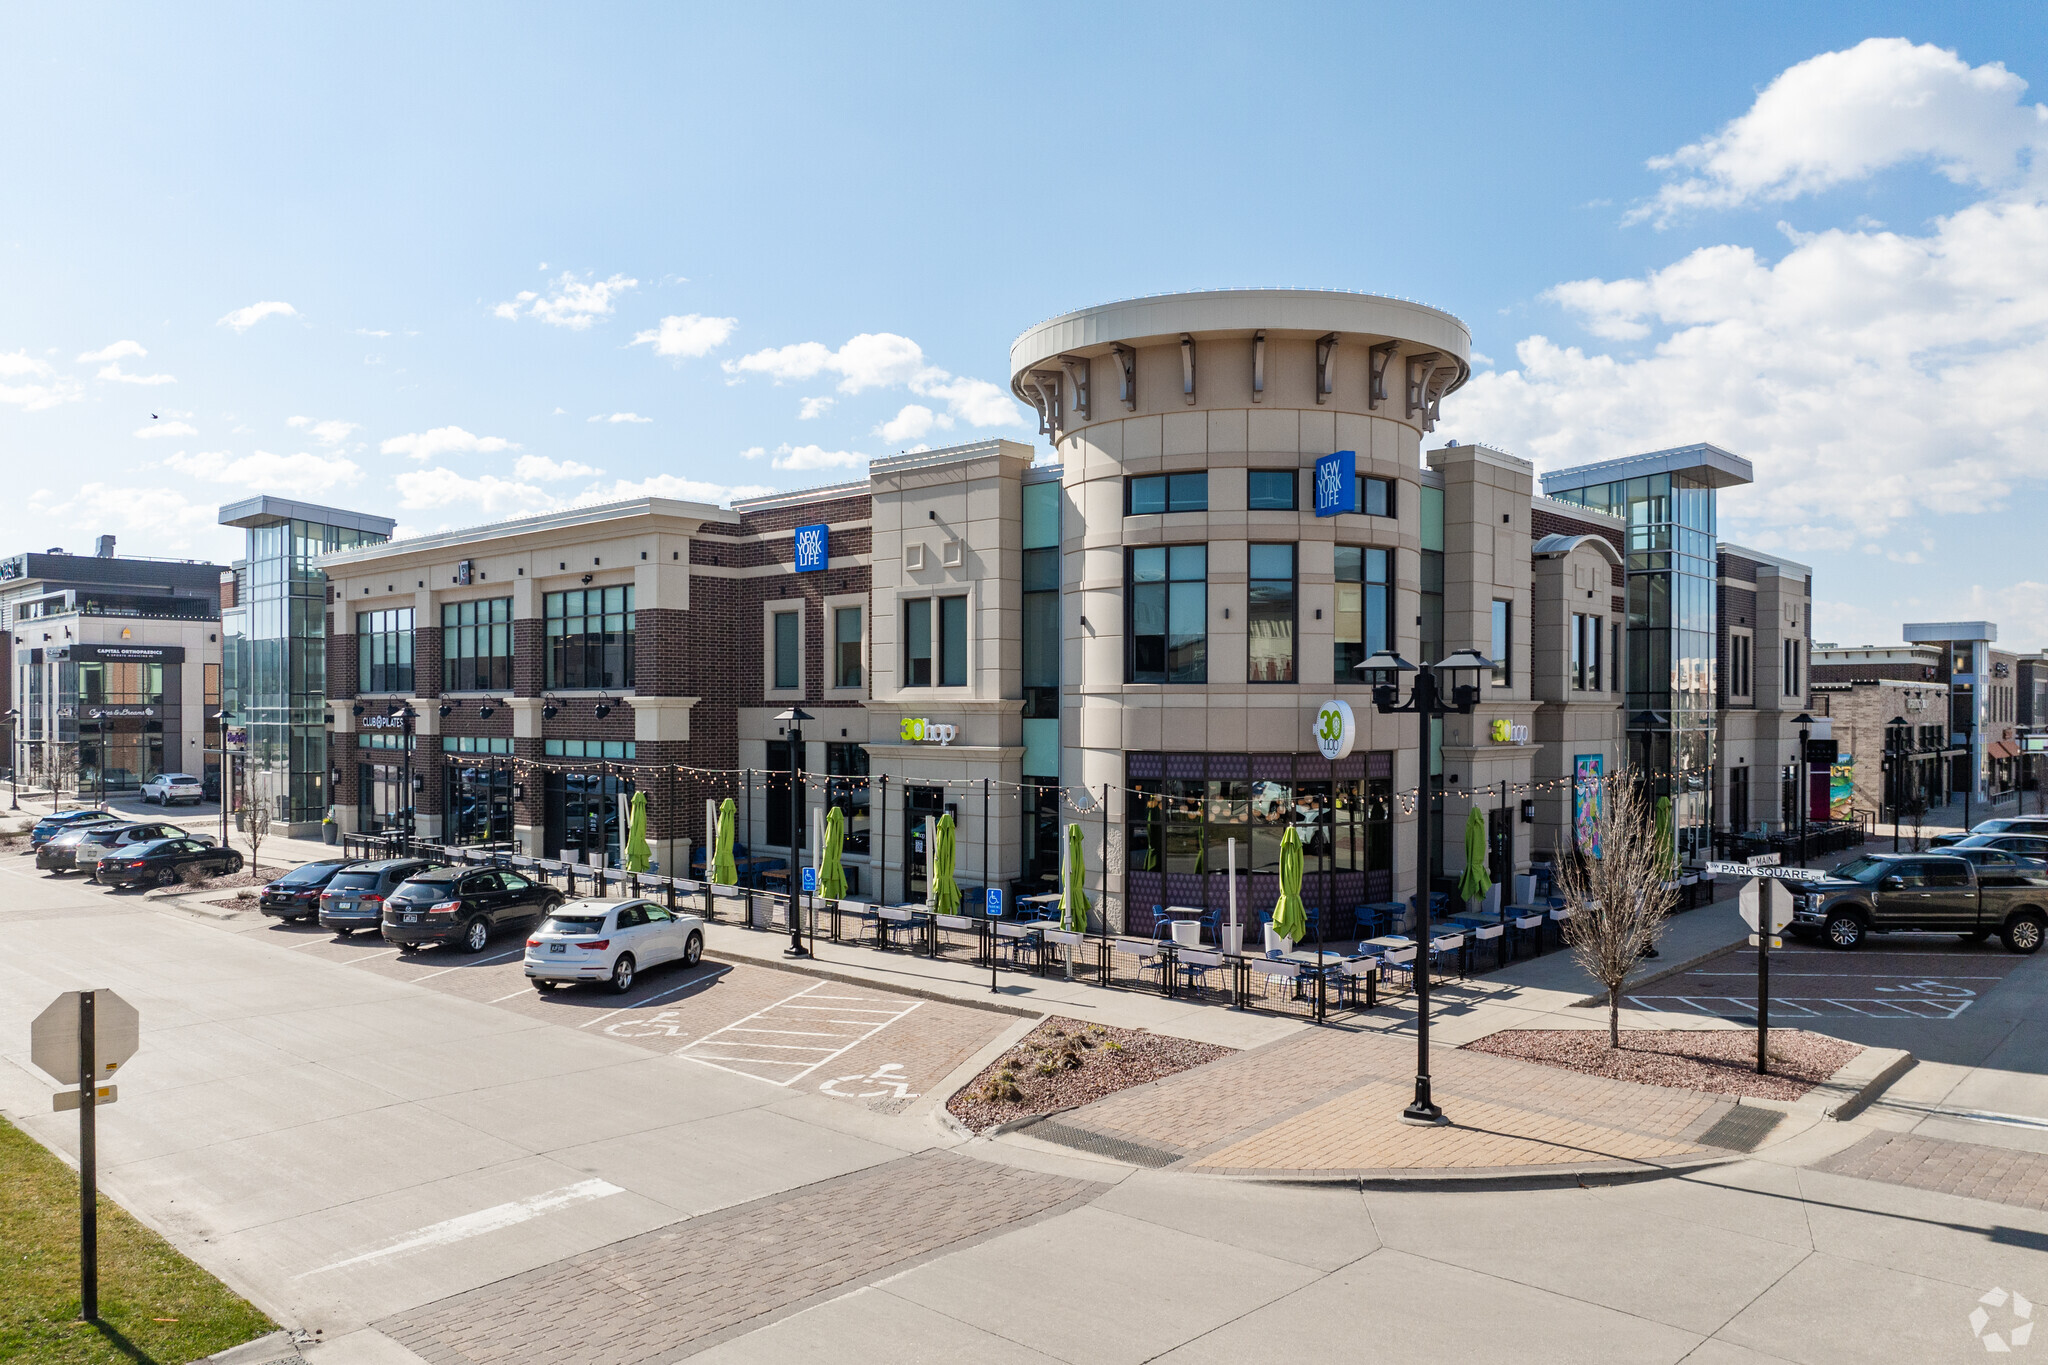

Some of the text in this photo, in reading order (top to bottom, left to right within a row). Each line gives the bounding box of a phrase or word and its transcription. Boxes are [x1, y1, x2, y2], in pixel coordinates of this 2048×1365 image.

[1321, 459, 1340, 480] NEW
[1318, 473, 1342, 495] YORK
[1321, 490, 1339, 509] LIFE
[800, 530, 820, 545] NEW
[797, 541, 822, 556] YORK
[800, 553, 820, 567] LIFE
[363, 717, 404, 728] CLUB PILATES
[900, 718, 956, 746] 30hop
[1320, 710, 1342, 741] 30
[1493, 719, 1529, 746] 30hop
[1323, 733, 1340, 755] hop
[1756, 855, 1774, 866] MAIN
[1721, 864, 1754, 875] PARK
[1756, 867, 1809, 879] SQUARE
